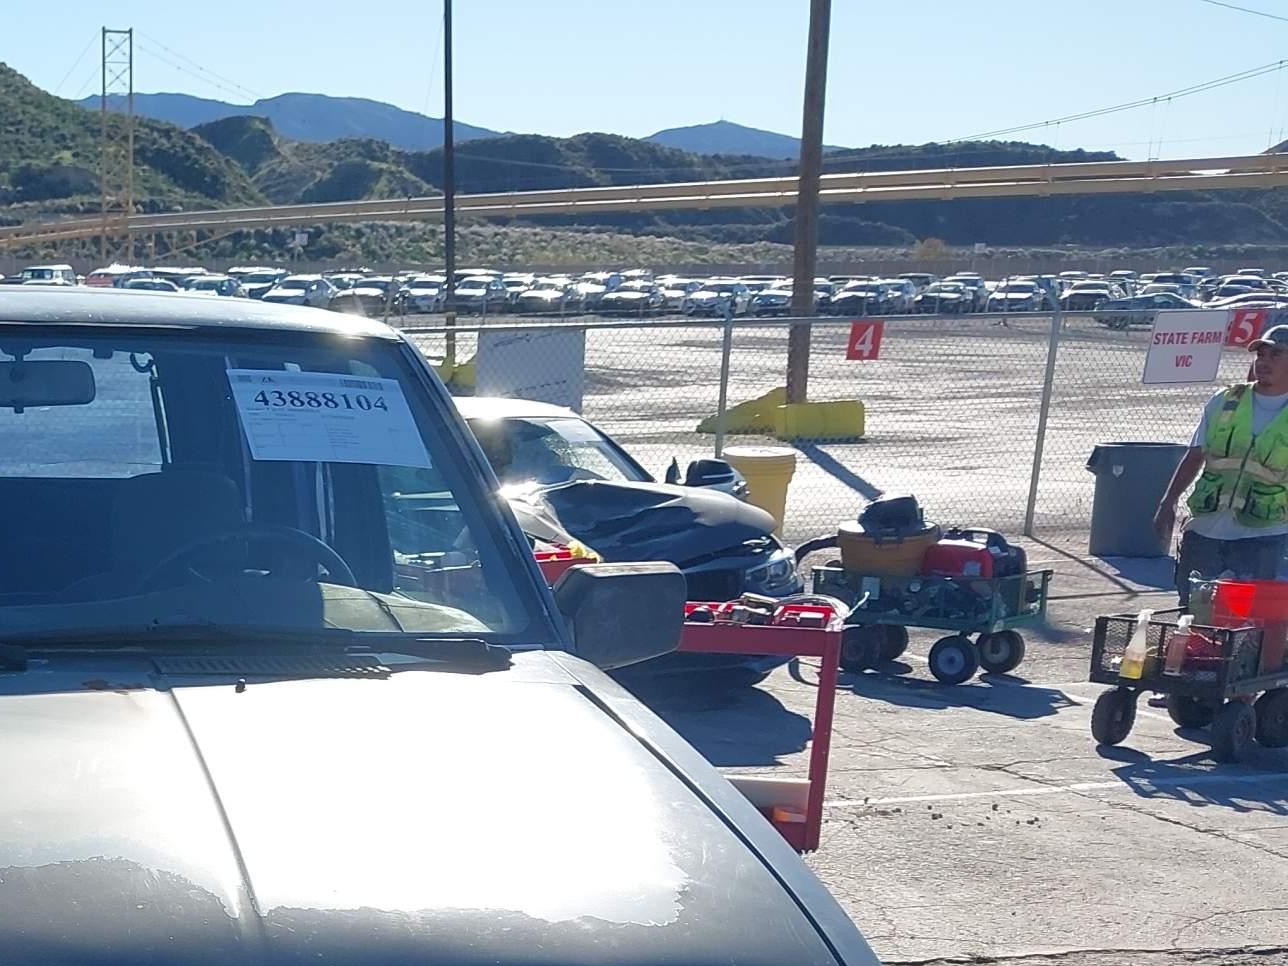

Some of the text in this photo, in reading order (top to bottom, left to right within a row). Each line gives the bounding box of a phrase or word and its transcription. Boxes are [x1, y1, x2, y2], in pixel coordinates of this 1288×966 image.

[1153, 331, 1223, 345] STATE FARM
[1234, 313, 1258, 343] 5
[855, 324, 875, 357] 4
[1175, 355, 1193, 367] VIC
[254, 390, 389, 412] 43888104
